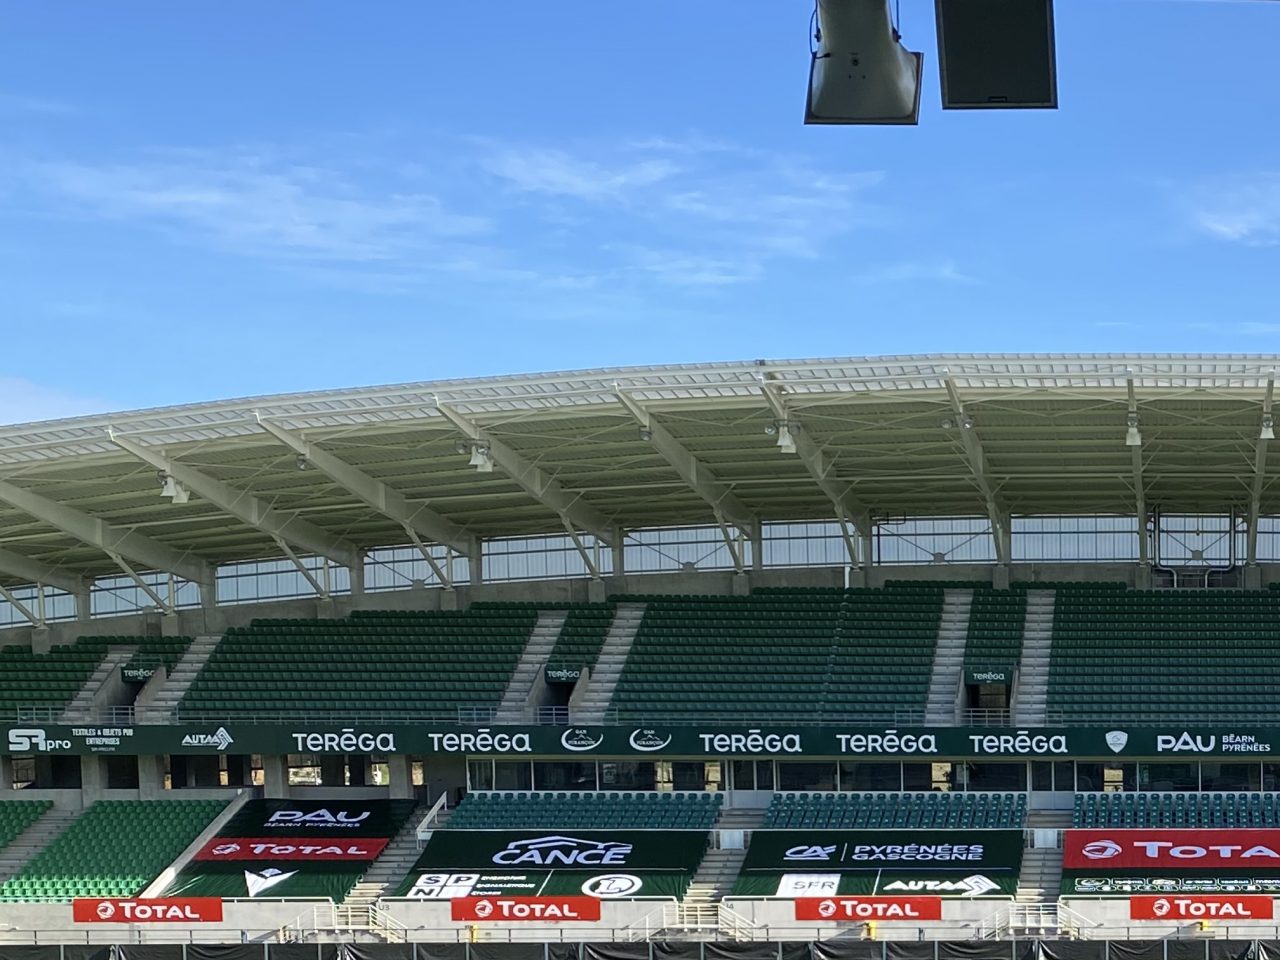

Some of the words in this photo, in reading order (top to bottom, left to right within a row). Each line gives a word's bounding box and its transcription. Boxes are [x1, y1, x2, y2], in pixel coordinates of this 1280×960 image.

[1158, 732, 1216, 752] PAU
[269, 809, 370, 822] PAU
[250, 844, 367, 855] TOTAL
[854, 844, 984, 853] PYRÉNÉES
[851, 853, 983, 861] GASCOGNE
[793, 881, 836, 890] SFR
[119, 902, 199, 918] TOTAL
[497, 901, 578, 917] TOTAL
[841, 901, 919, 916] TOTAL
[1174, 900, 1252, 916] TOTAL
